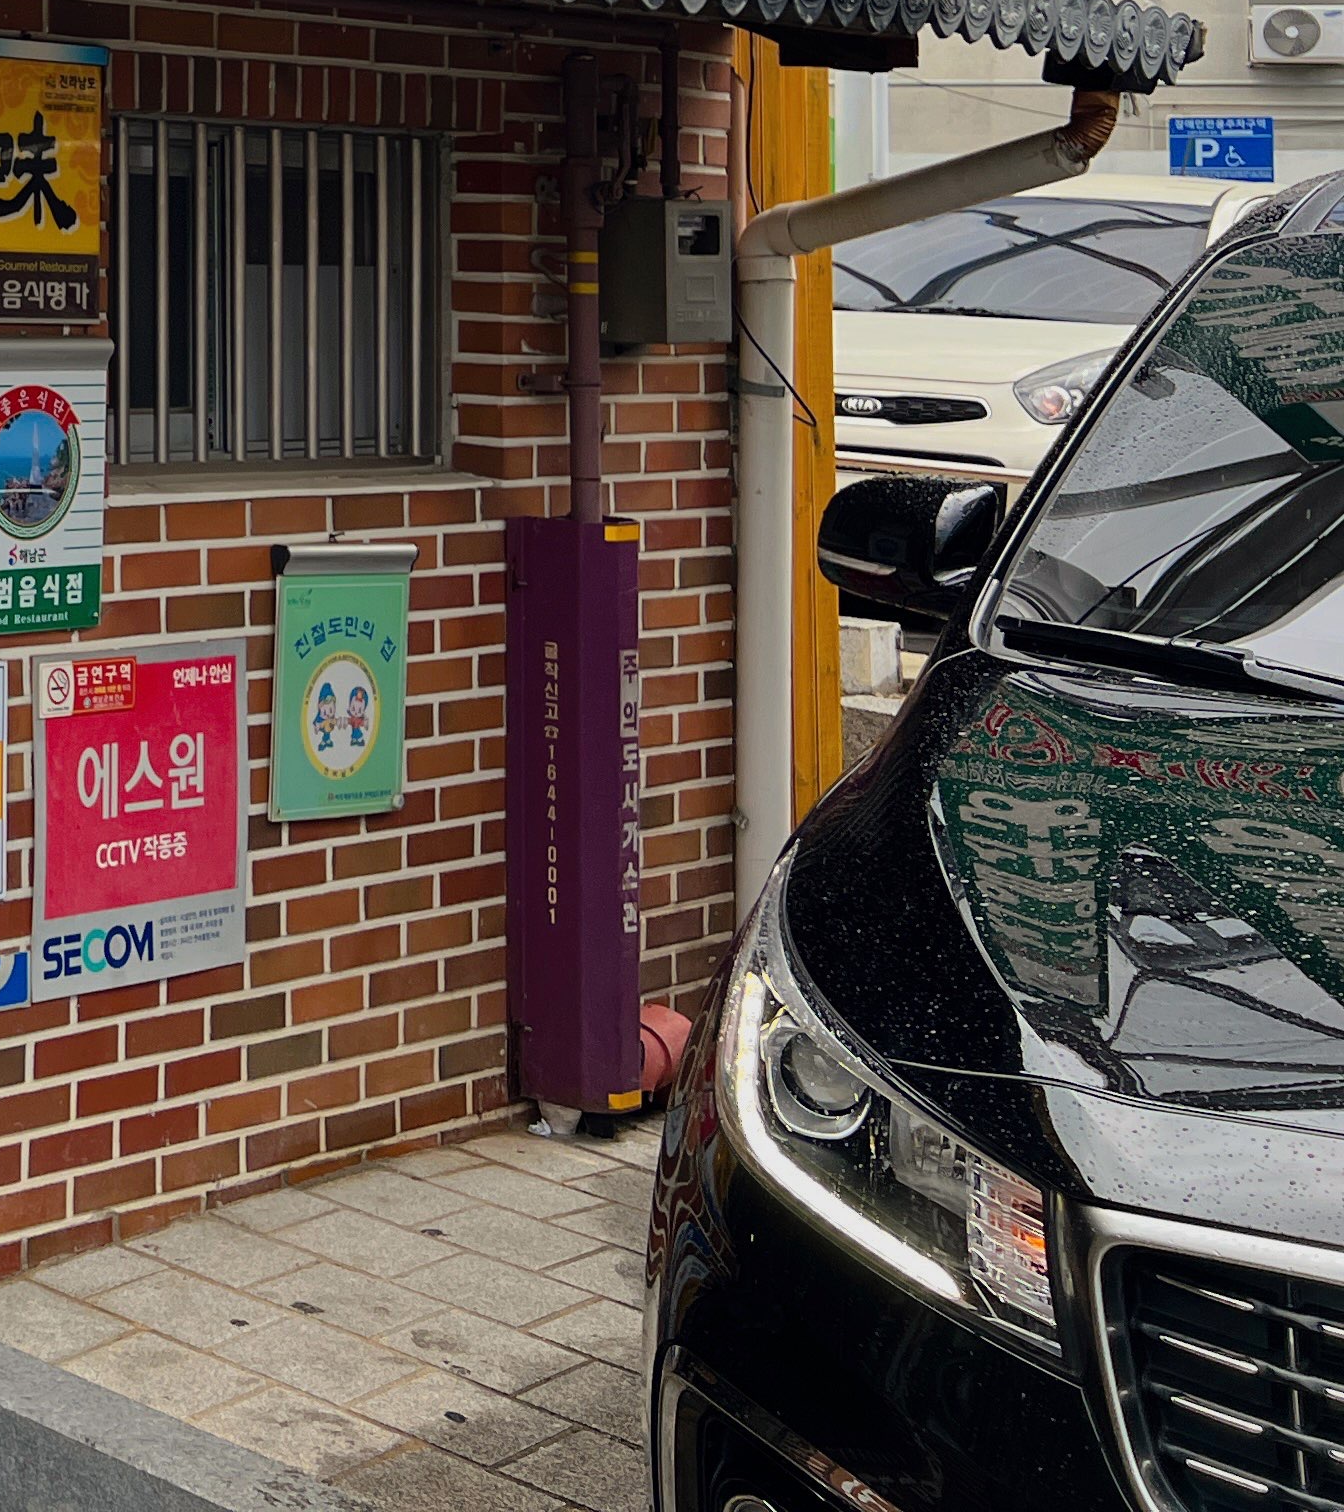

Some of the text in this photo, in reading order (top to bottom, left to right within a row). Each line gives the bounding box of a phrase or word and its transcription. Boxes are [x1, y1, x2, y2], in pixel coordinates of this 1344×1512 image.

[1195, 138, 1221, 167] P
[39, 259, 89, 274] Restaurant
[846, 398, 875, 412] KIA
[18, 546, 48, 564] 해남군
[13, 610, 69, 625] Restaurant
[292, 614, 398, 665] 친절도민의 집
[76, 663, 132, 686] 금연구역
[172, 663, 233, 689] 언제나 안심
[543, 640, 560, 721] 굴착신고
[621, 651, 639, 735] 주의
[76, 732, 207, 819] 에스원
[95, 830, 189, 870] CCTV 작동중
[546, 743, 558, 926] 1644-0001
[43, 920, 155, 981] SECOM
